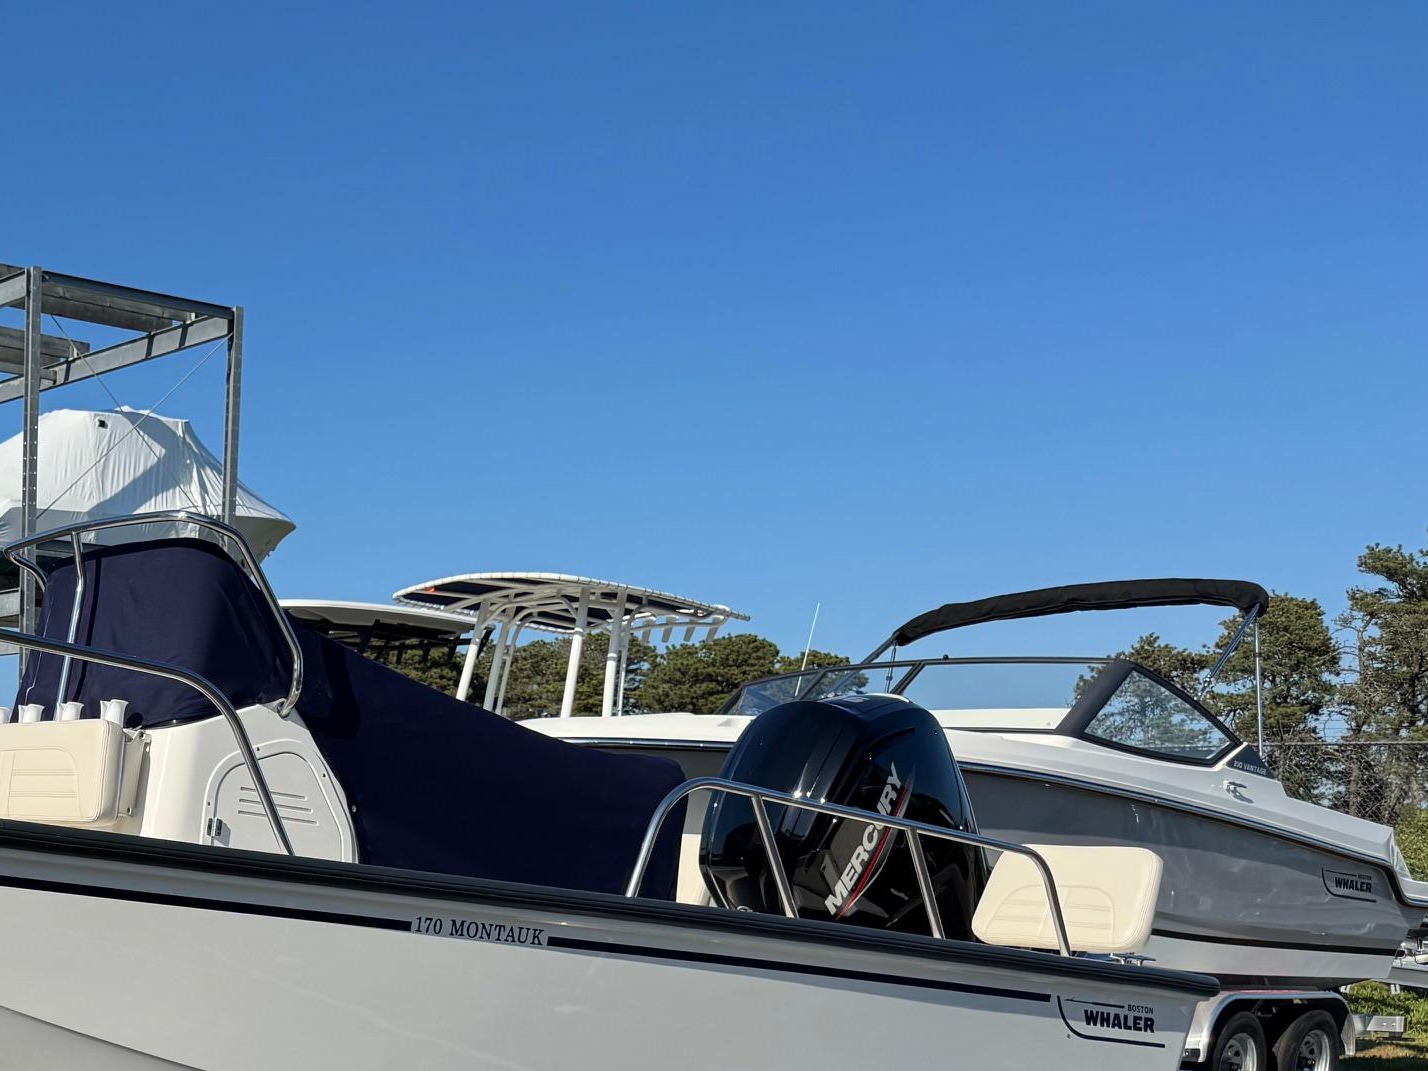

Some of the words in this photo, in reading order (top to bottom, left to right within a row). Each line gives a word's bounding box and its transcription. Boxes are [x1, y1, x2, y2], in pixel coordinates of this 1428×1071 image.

[1334, 876, 1372, 893] WHALER
[414, 916, 443, 935] 170
[449, 919, 545, 946] MONTAUK
[1127, 1004, 1154, 1015] BOSTON
[1083, 1009, 1155, 1033] WHALER
